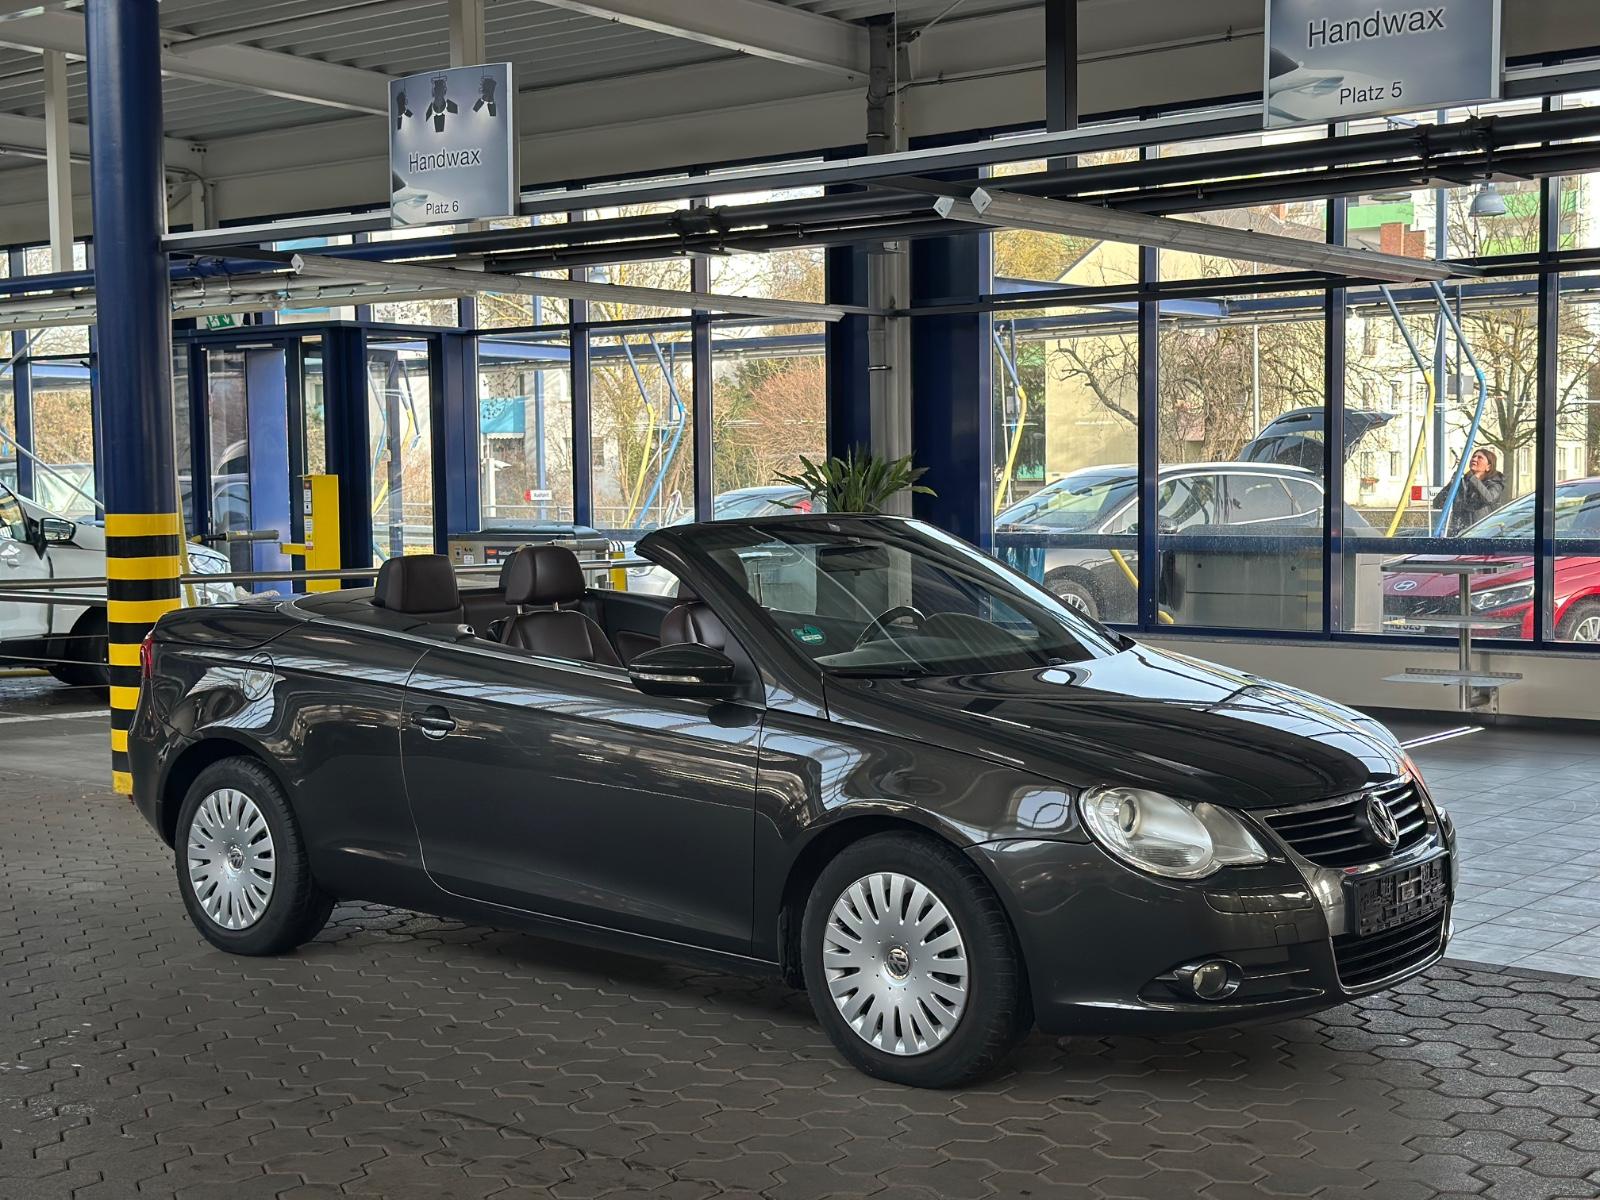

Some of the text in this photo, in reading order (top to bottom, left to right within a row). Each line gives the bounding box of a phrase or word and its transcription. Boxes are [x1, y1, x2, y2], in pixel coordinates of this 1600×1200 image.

[1308, 8, 1445, 48] Handwax
[1340, 81, 1403, 105] Platz 5
[409, 148, 481, 173] Handwax
[426, 200, 459, 215] Platz 6
